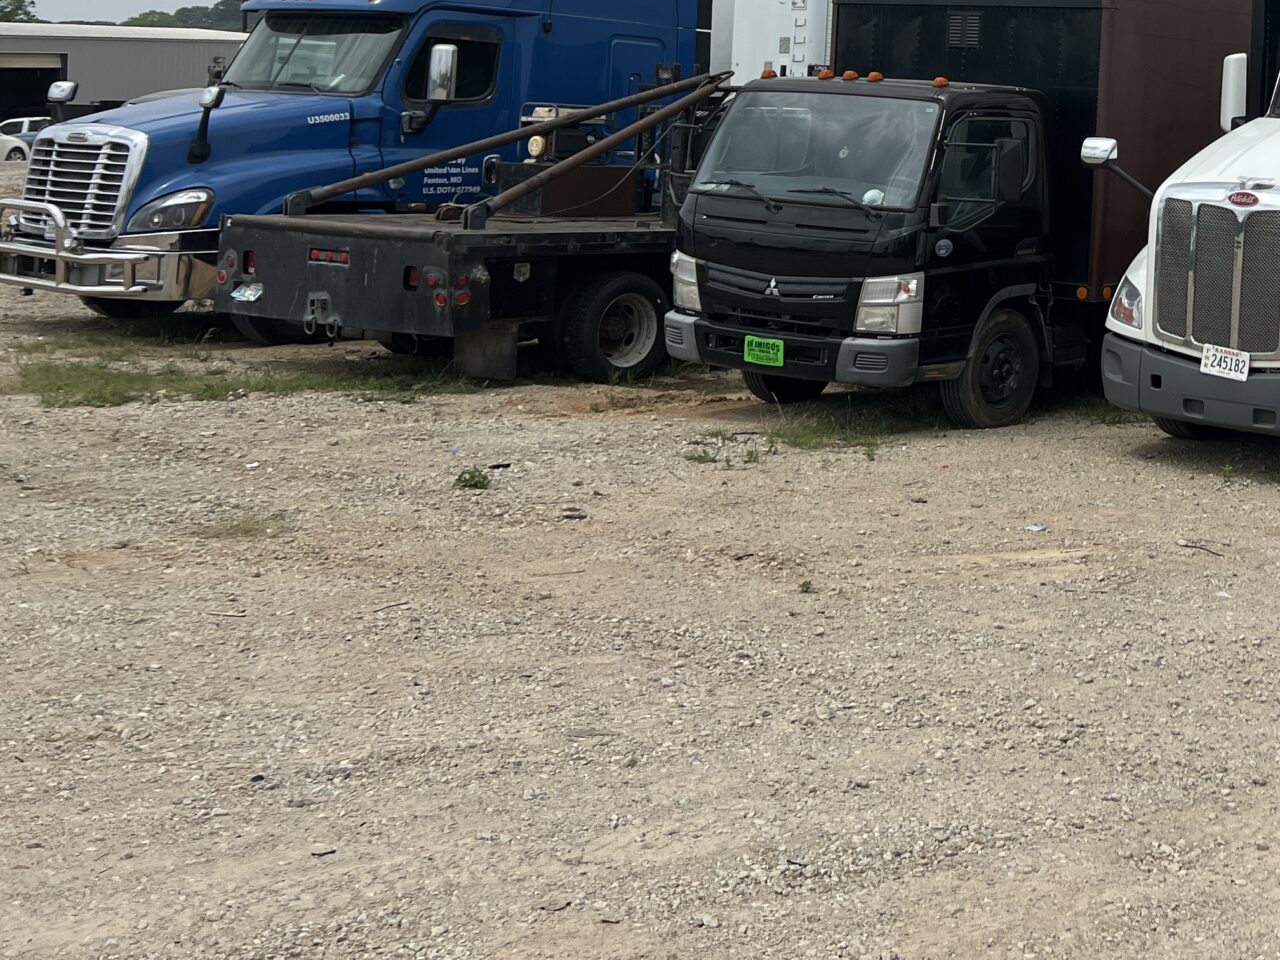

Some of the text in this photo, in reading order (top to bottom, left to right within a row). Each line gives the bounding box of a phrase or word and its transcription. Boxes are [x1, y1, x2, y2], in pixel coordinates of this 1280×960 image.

[307, 112, 350, 124] U3500033
[424, 166, 448, 174] United
[755, 341, 780, 352] AMIGOS
[1210, 353, 1246, 374] 245182
